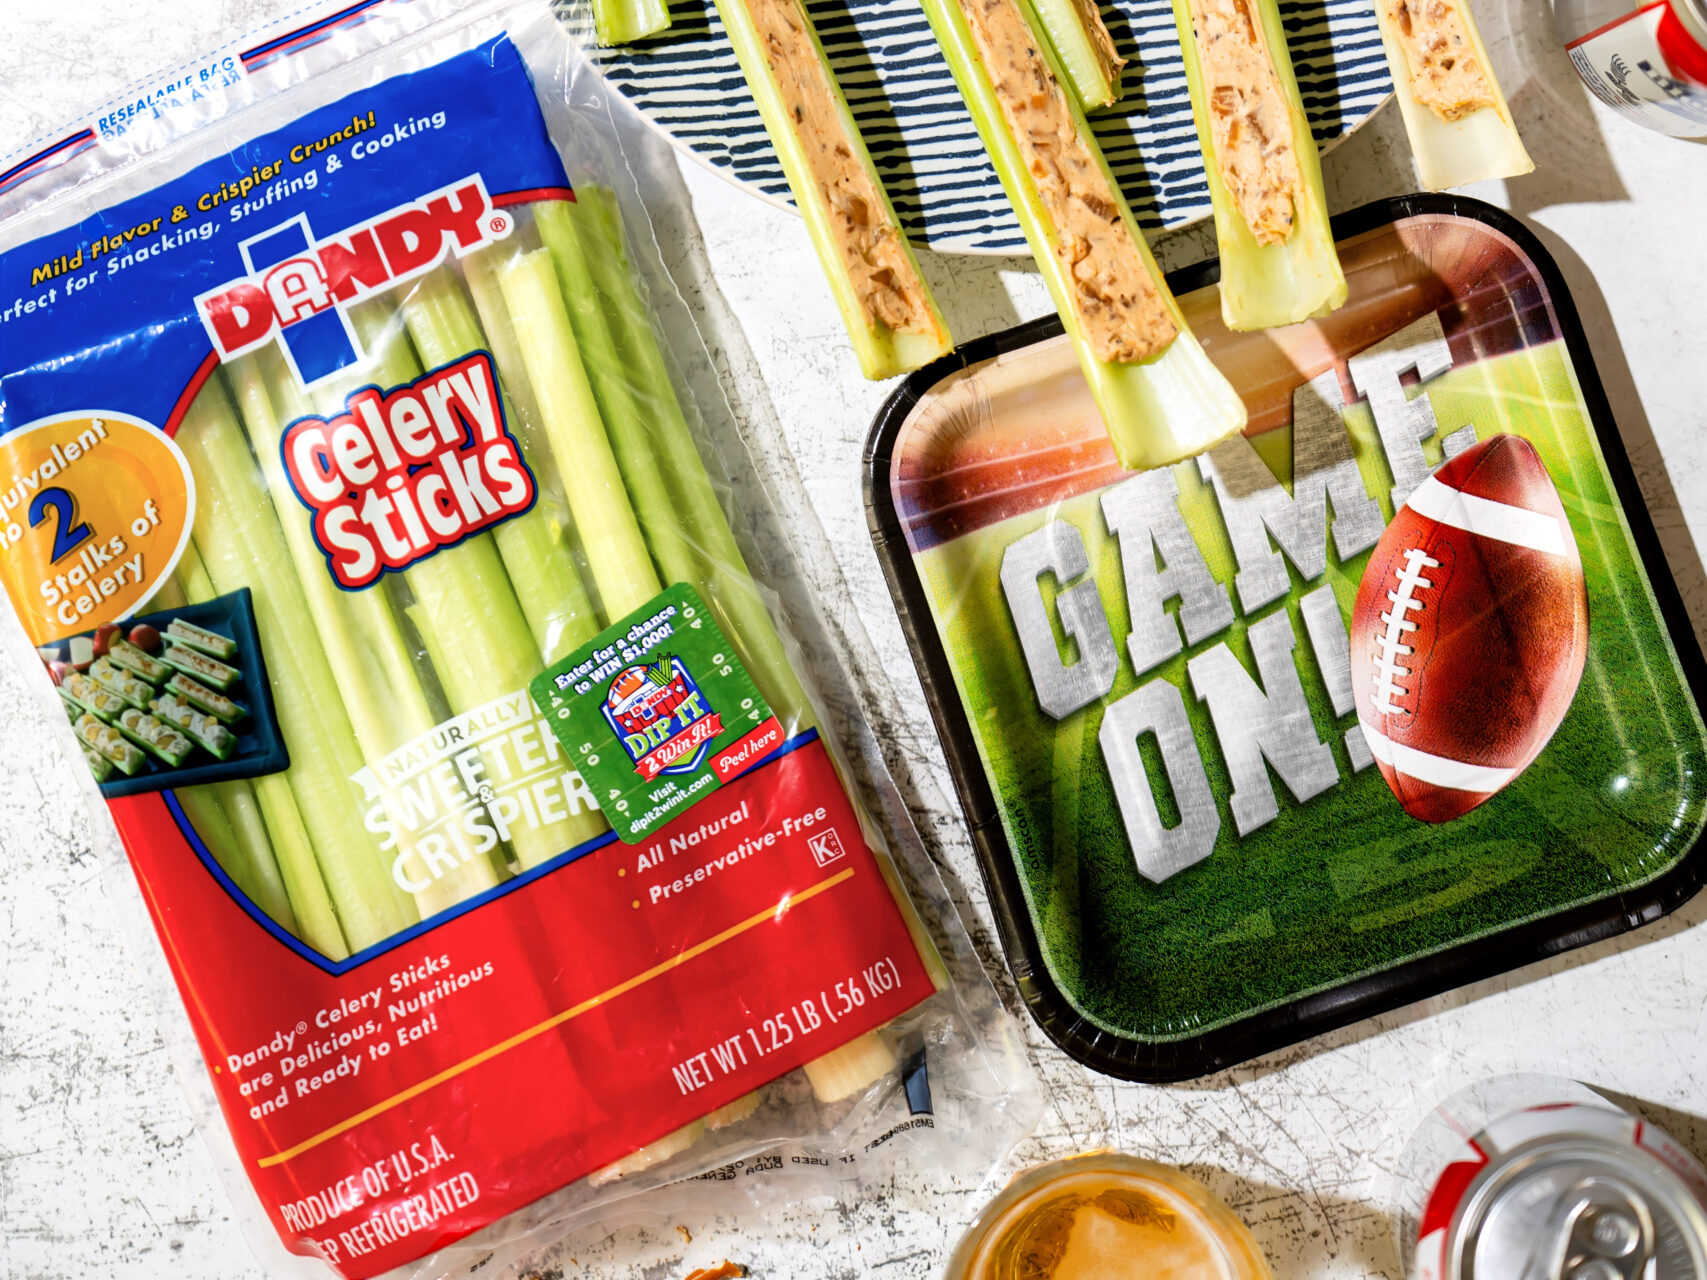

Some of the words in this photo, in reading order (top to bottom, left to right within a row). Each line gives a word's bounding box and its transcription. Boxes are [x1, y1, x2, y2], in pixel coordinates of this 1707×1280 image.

[200, 57, 235, 82] BAG
[0, 288, 57, 323] rfect
[65, 270, 98, 295] for
[107, 221, 220, 275] Snacking,
[230, 169, 318, 222] Stuffing
[325, 154, 343, 173] &
[351, 111, 446, 160] Cooking
[31, 249, 83, 287] Mild
[91, 217, 162, 260] Flavor
[171, 205, 188, 223] &
[197, 159, 283, 211] Crispier
[289, 110, 376, 163] Crunch!
[293, 363, 498, 502] Celery
[28, 486, 91, 565] 2
[40, 536, 125, 606] Stalks
[131, 499, 160, 537] of
[323, 444, 527, 579] Sticks
[1000, 312, 1478, 719] GAME
[57, 553, 141, 625] Celery
[553, 659, 595, 690] Enter
[593, 643, 616, 664] for
[615, 638, 628, 650] a
[627, 605, 677, 643] chance
[574, 680, 593, 695] to
[589, 656, 623, 684] WIN
[622, 623, 674, 663] $1,000!
[383, 698, 521, 779] NATURALLY
[624, 716, 672, 759] DIP
[673, 690, 705, 727] IT
[645, 757, 660, 773] 2
[657, 738, 691, 763] Win
[691, 718, 712, 743] It!
[719, 747, 749, 773] Peel
[750, 729, 777, 754] here
[1098, 584, 1376, 884] ON!
[392, 770, 602, 894] CRISPIER
[478, 784, 495, 804] &
[629, 773, 714, 833] dipit2winit.com
[648, 781, 678, 803] Visit
[637, 844, 665, 873] All
[669, 800, 749, 855] Natural
[649, 807, 827, 904] Preservative-Free
[239, 1072, 273, 1096] are
[280, 1020, 382, 1076] Delicious,
[388, 961, 494, 1022] Nutritious
[315, 987, 382, 1029] Celery
[389, 954, 450, 992] Sticks
[672, 1052, 714, 1095] NET
[710, 1034, 748, 1074] WT
[747, 1012, 794, 1057] 1.25
[792, 999, 822, 1035] LB
[821, 977, 865, 1023] (.56
[862, 957, 901, 999] KG)
[249, 1087, 289, 1120] and
[295, 1054, 361, 1098] Ready
[369, 1043, 391, 1061] to
[397, 1013, 438, 1047] Eat!
[279, 1175, 364, 1233] PRODUCE
[362, 1160, 390, 1198] OF
[391, 1134, 455, 1183] U.S.A.
[339, 1172, 479, 1258] REFRIGERATED
